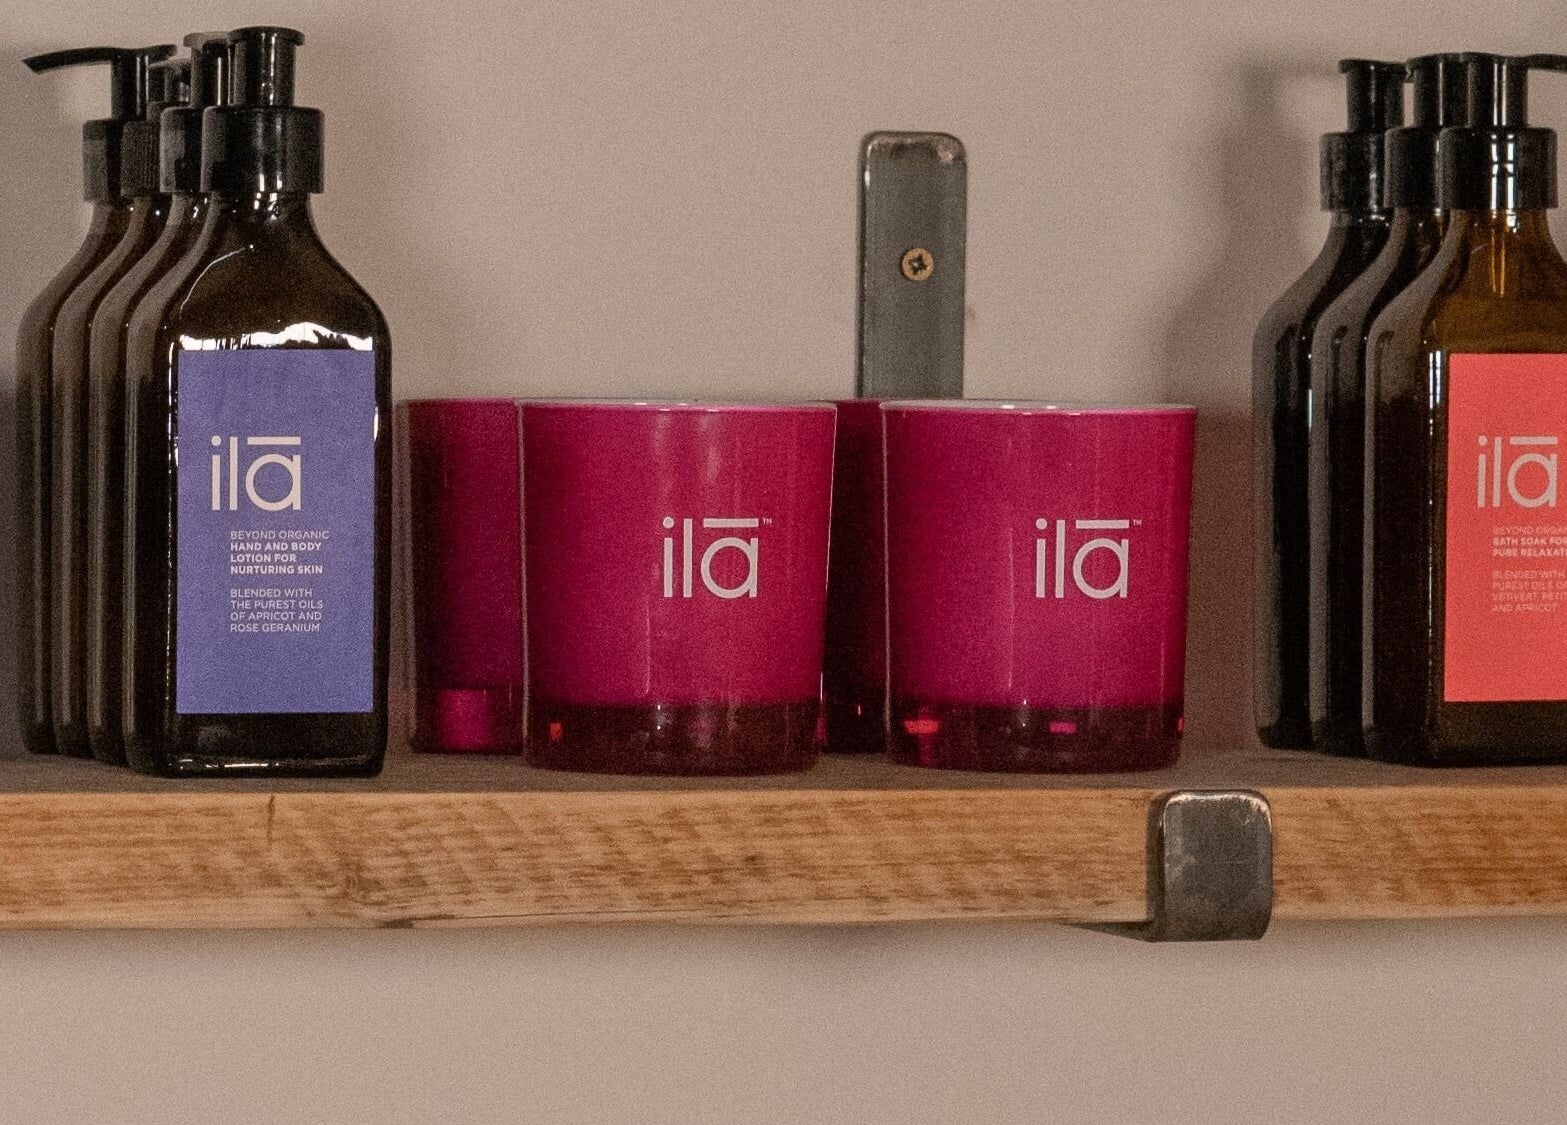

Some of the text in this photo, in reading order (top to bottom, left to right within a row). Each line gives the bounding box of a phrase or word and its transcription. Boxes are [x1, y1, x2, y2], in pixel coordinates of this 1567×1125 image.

[230, 530, 330, 540] BEYOND ORGANIC
[1493, 537, 1519, 546] BATH
[1520, 537, 1547, 546] SOAK
[230, 542, 322, 551] HAND AND BODY
[230, 554, 297, 563] LOTION FOR
[230, 565, 323, 574] NURTURING SKIN
[230, 588, 313, 598] BLENDED WITH
[230, 600, 324, 609] THE PUREST OILS
[230, 611, 322, 621] OF APRICOT AND
[230, 623, 320, 632] ROSE GERANIUM
